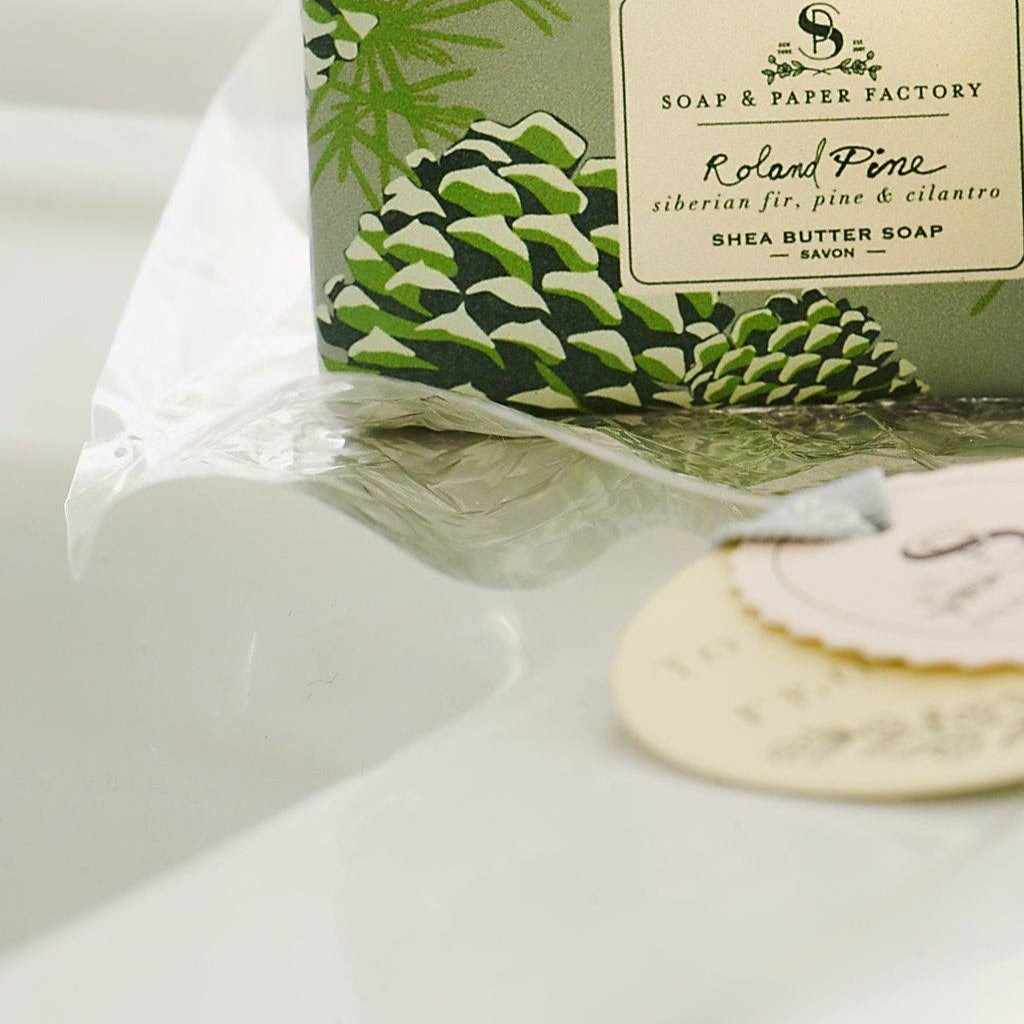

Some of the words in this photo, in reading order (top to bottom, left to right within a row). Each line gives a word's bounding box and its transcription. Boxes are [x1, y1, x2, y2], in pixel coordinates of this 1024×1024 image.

[662, 93, 728, 110] SOAP
[741, 90, 757, 106] &
[771, 89, 851, 106] PAPER
[865, 83, 983, 102] FACTORY
[703, 137, 827, 188] Roland
[829, 145, 947, 178] Pine
[652, 193, 750, 212] siberian
[758, 192, 800, 215] fir,
[813, 190, 864, 211] pine
[877, 188, 893, 203] &
[905, 185, 1002, 203] cilantro
[712, 231, 772, 246] SHEA
[783, 228, 872, 244] BUTTER
[882, 225, 944, 240] SOAP
[800, 248, 855, 260] SAVON
